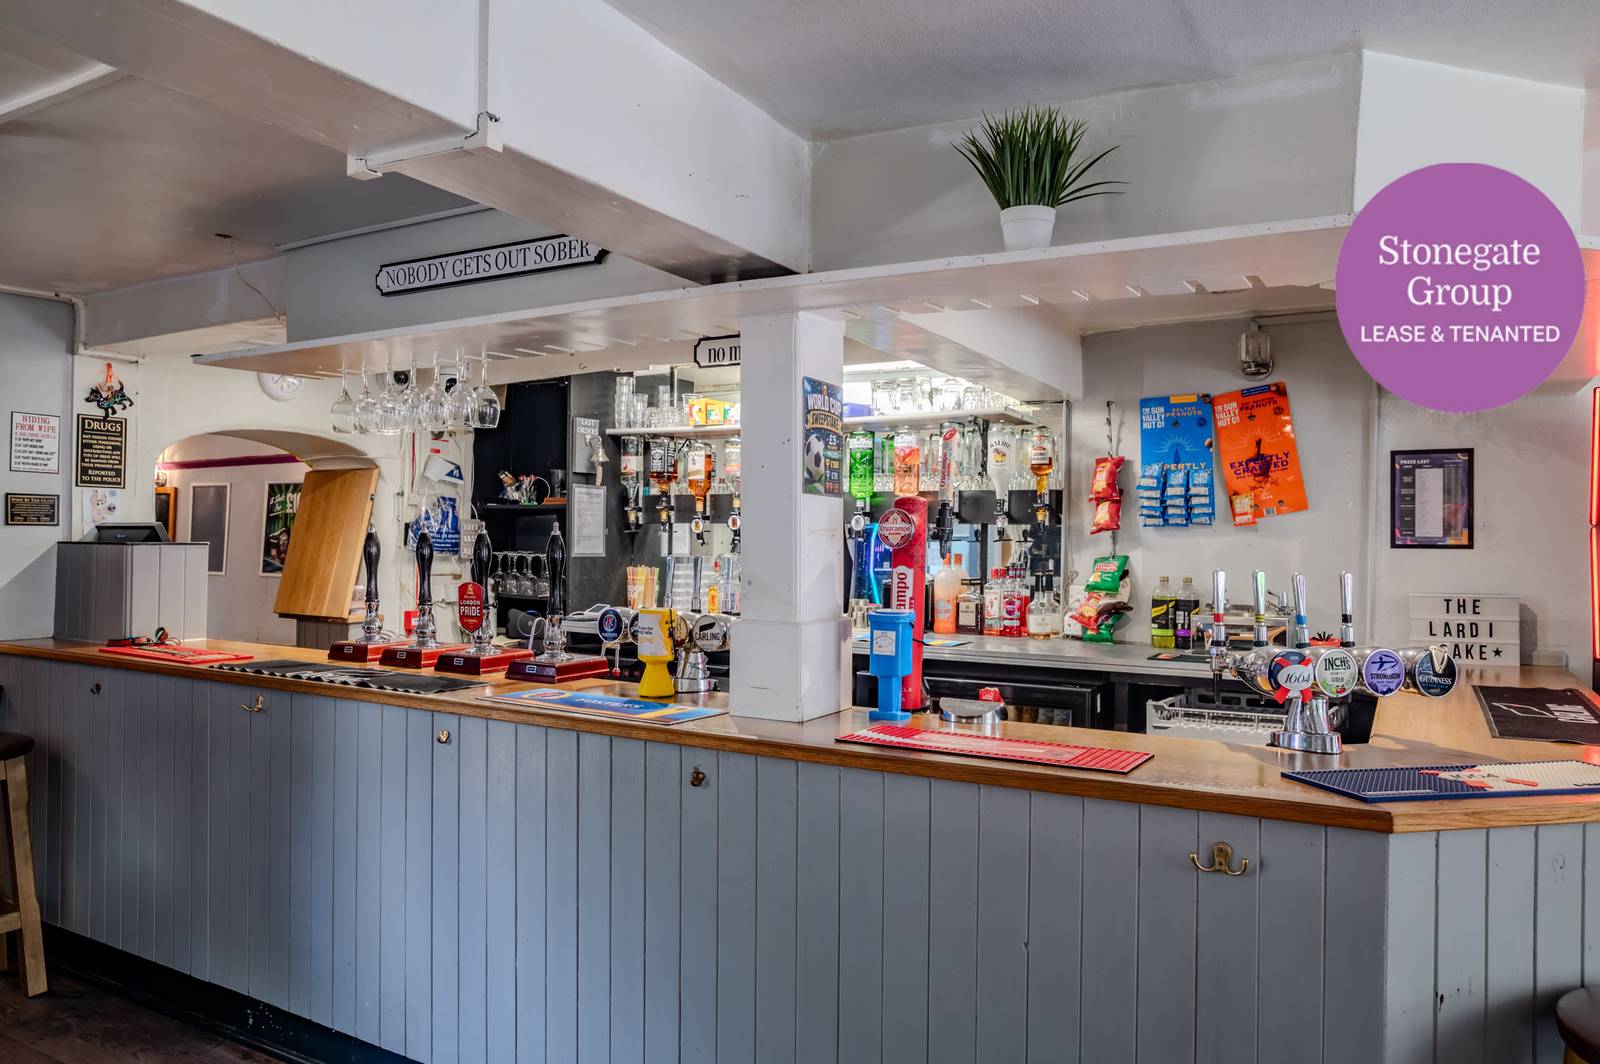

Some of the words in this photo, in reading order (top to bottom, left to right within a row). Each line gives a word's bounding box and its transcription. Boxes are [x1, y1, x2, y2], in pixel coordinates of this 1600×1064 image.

[386, 260, 450, 288] NOBODY
[452, 252, 491, 278] GETS
[494, 247, 531, 271] OUT
[533, 239, 592, 265] SOBER
[708, 347, 725, 363] no
[807, 393, 830, 411] WORLD
[1223, 402, 1238, 410] SUN
[1151, 406, 1165, 414] SUN
[1215, 409, 1240, 419] VALLEY
[22, 415, 50, 424] HIDING
[581, 418, 594, 426] LAST
[1142, 413, 1165, 421] VALLEY
[15, 422, 35, 431] FROM
[38, 425, 57, 433] WIFE
[84, 419, 121, 432] DRUGS
[1143, 421, 1156, 429] NUT
[1217, 418, 1231, 427] NUT
[577, 427, 599, 435] ORDERS
[1443, 598, 1481, 614] THE
[460, 606, 481, 617] PRIDE
[694, 631, 721, 641] CARLING
[1439, 643, 1488, 660] AKE
[1284, 670, 1312, 684] 1664
[1370, 672, 1402, 680] STRONGBOW
[1418, 674, 1453, 685] GUINNESS
